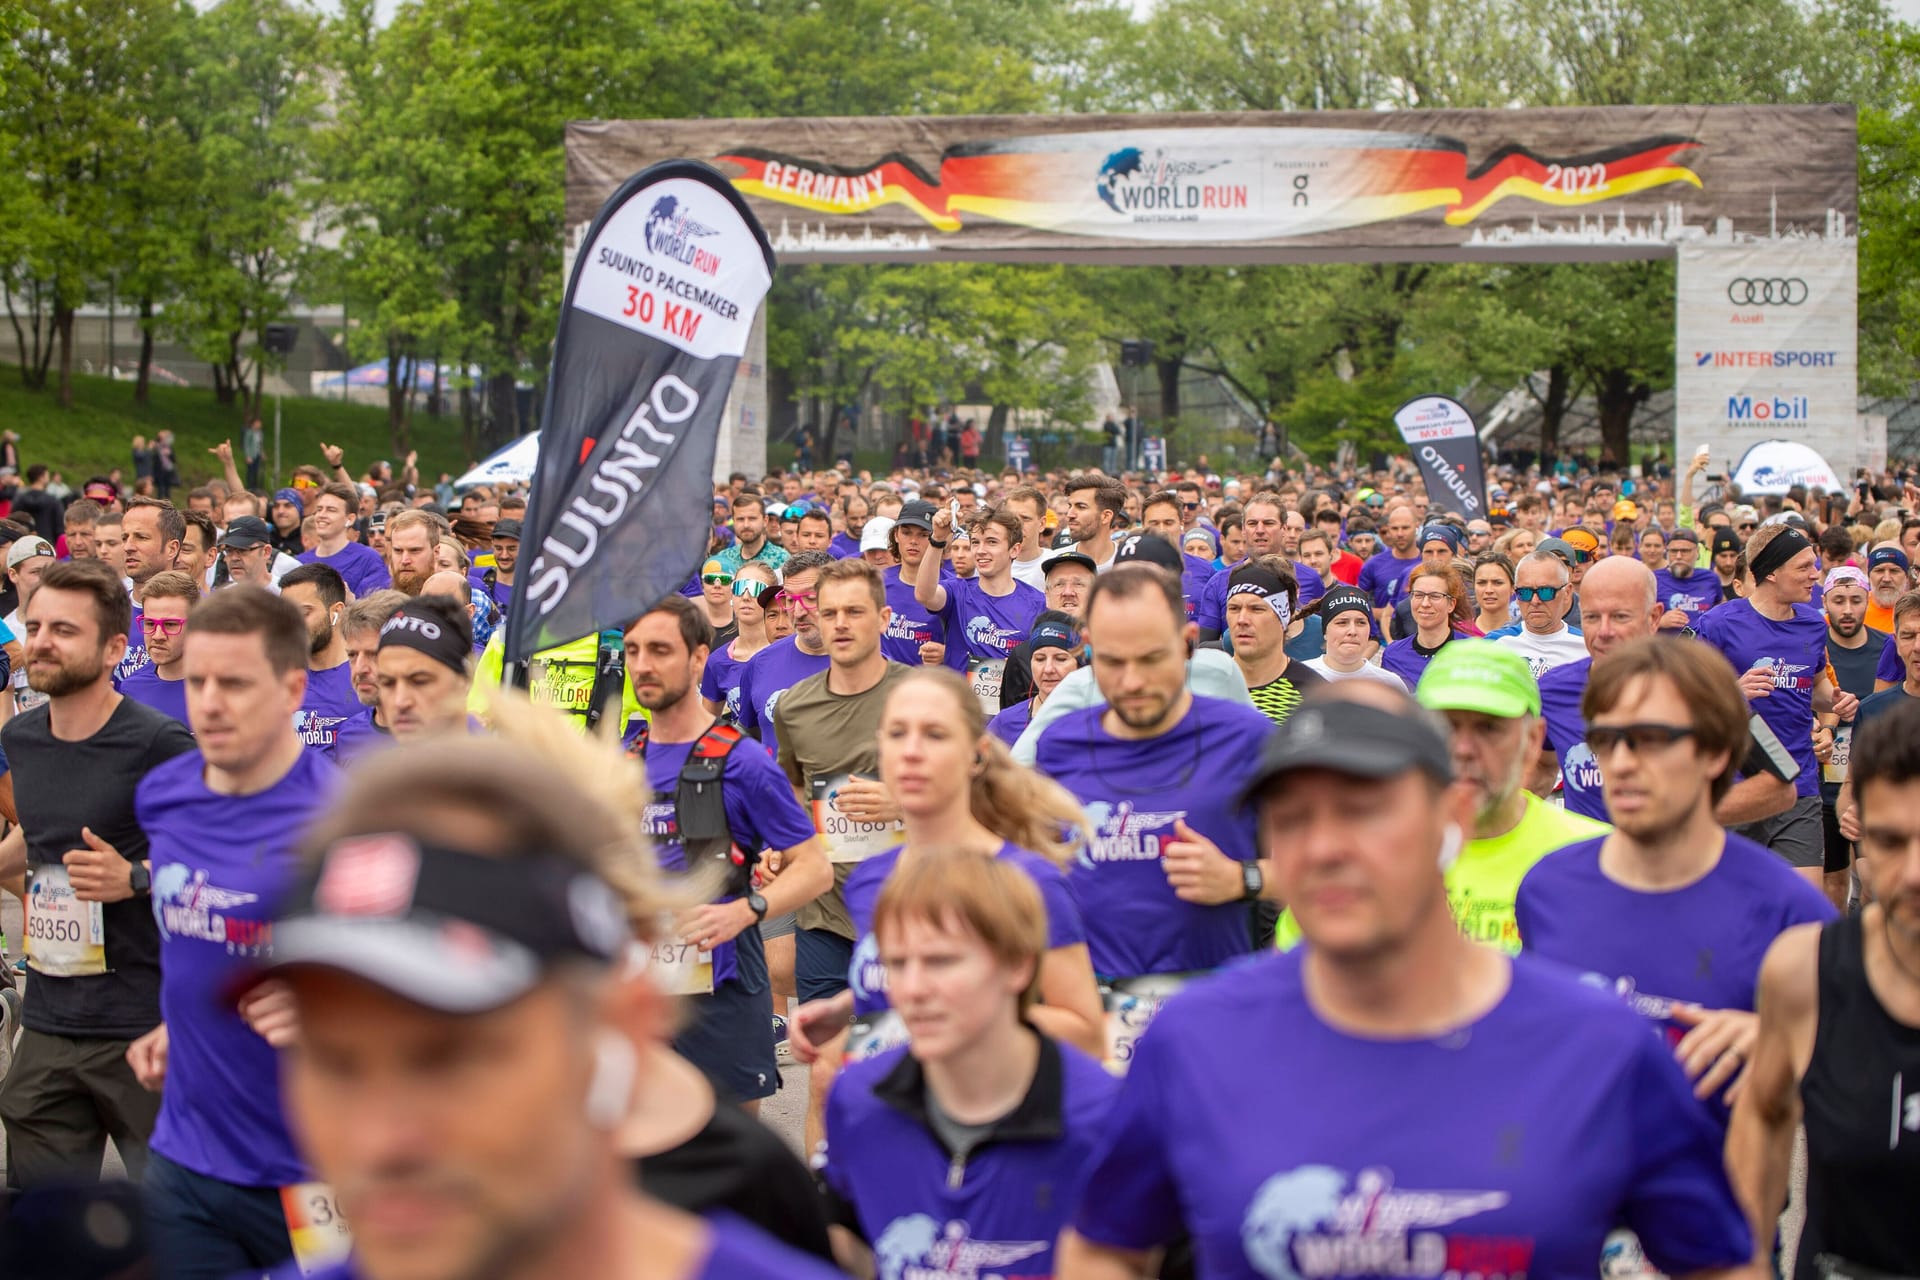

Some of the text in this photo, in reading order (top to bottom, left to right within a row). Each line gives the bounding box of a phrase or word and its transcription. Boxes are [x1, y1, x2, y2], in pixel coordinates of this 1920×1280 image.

[763, 160, 885, 205] GERMANY
[1542, 164, 1610, 195] 2022
[1122, 185, 1248, 209] WORLD RUN
[654, 230, 721, 276] WORLD RUN
[598, 247, 740, 321] SUUNTO PACEMAKER
[622, 285, 703, 342] 30 KM
[1729, 314, 1765, 324] Audi
[1715, 351, 1837, 368] INTERSPORT
[1728, 397, 1808, 420] Mobil
[526, 374, 700, 615] SUUNTO
[888, 627, 915, 640] WORLD
[977, 631, 1006, 648] WORLD
[1771, 676, 1797, 689] ORLD
[1092, 834, 1160, 862] WORLD
[29, 916, 81, 942] 59350
[163, 904, 226, 943] WORLD
